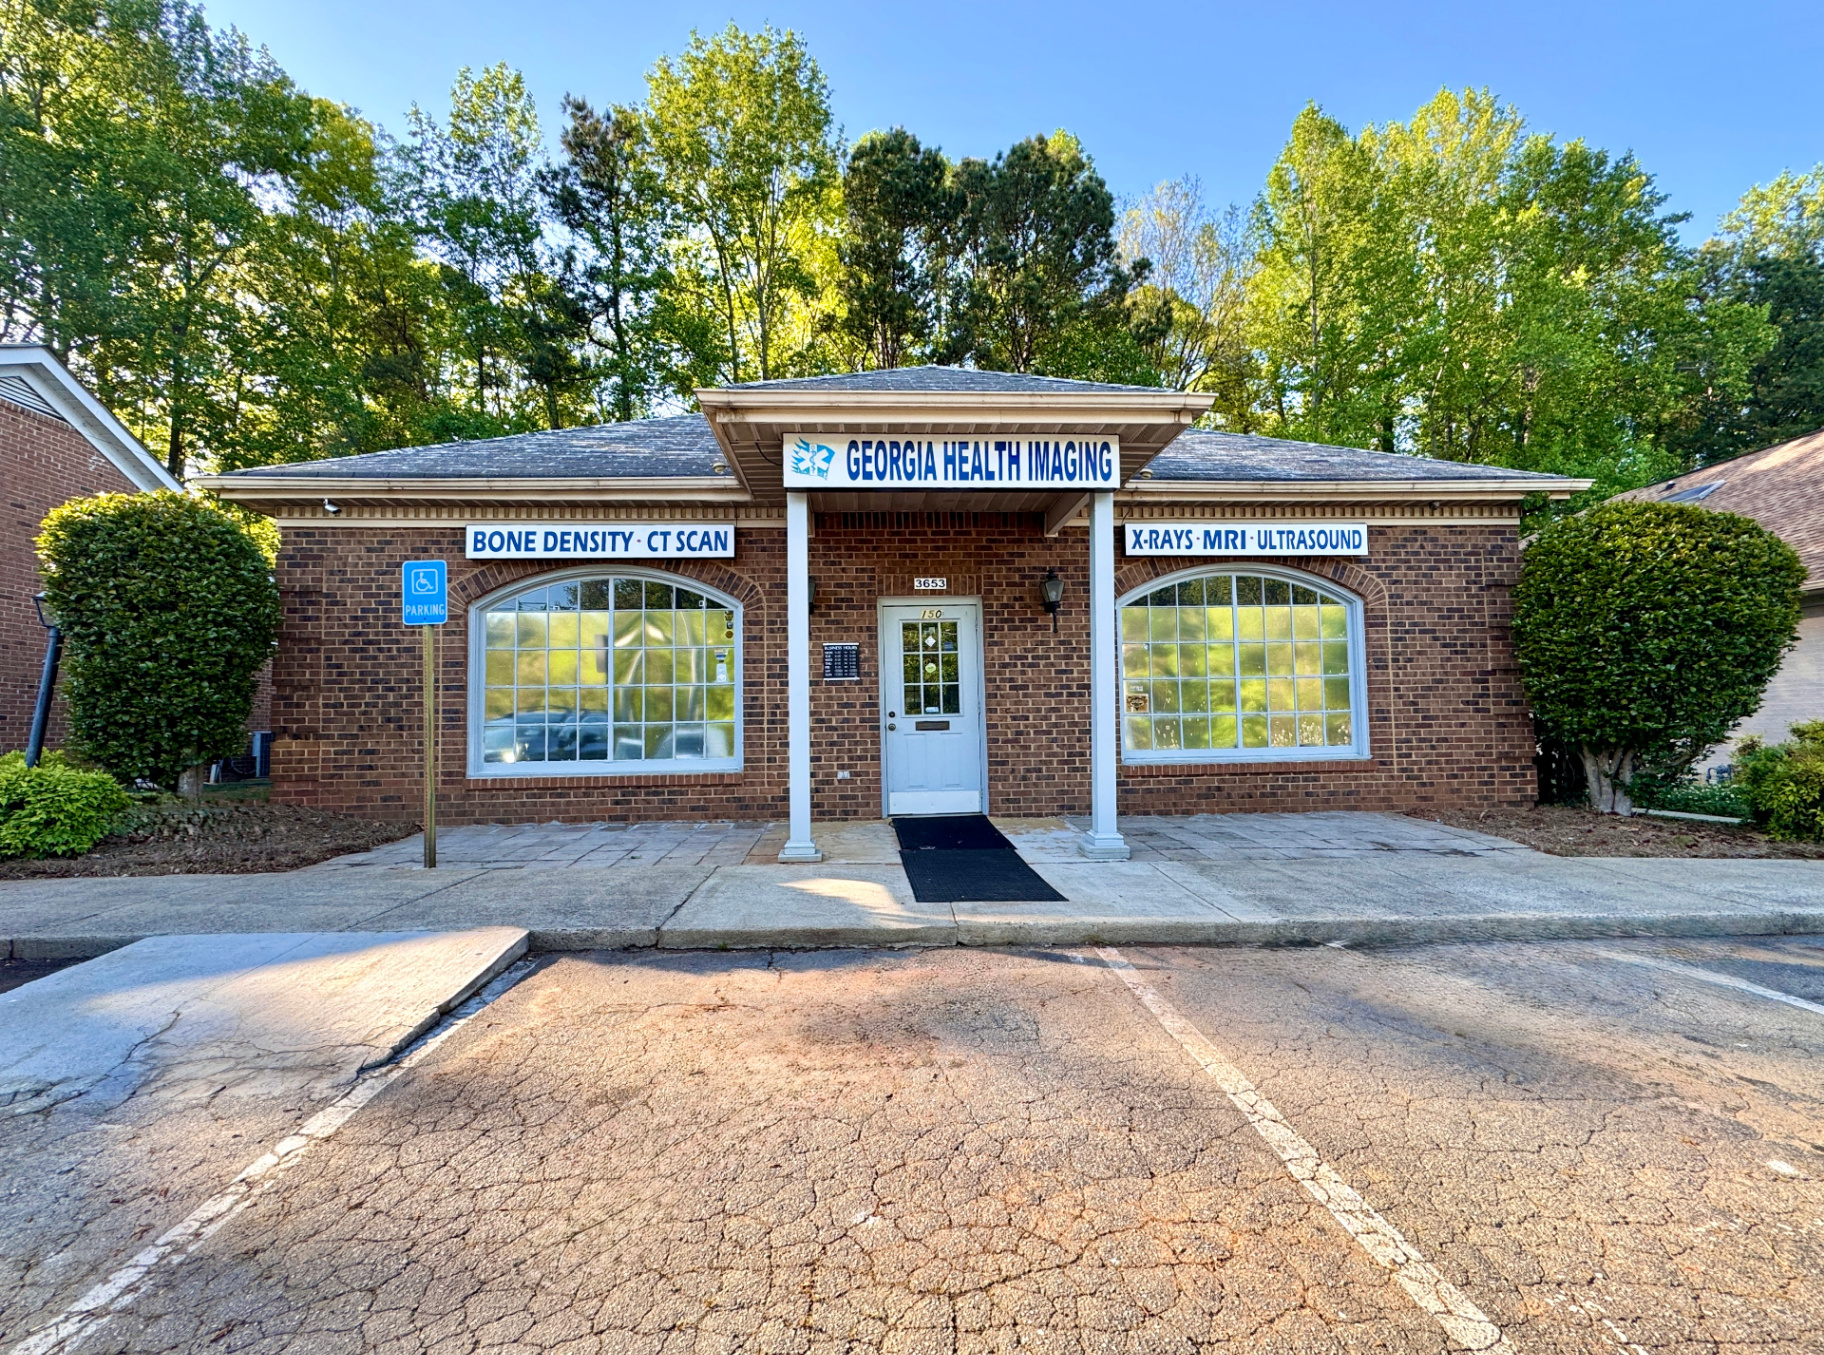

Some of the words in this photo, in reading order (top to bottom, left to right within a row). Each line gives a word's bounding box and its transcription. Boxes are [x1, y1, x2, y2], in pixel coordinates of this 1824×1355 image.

[847, 440, 937, 482] GEORGIA
[943, 440, 1020, 482] HEALTH
[1028, 441, 1113, 482] IMAGING
[473, 531, 536, 552] BONE
[543, 531, 634, 552] DENSITY
[647, 531, 671, 552] CT
[676, 531, 728, 551] SCAN
[1132, 529, 1193, 550] X-RAYS
[1203, 529, 1247, 550] MRI
[1257, 529, 1362, 550] ULTRASOUND
[915, 579, 945, 588] 3653
[405, 604, 445, 616] PARKING
[922, 610, 942, 619] 150
